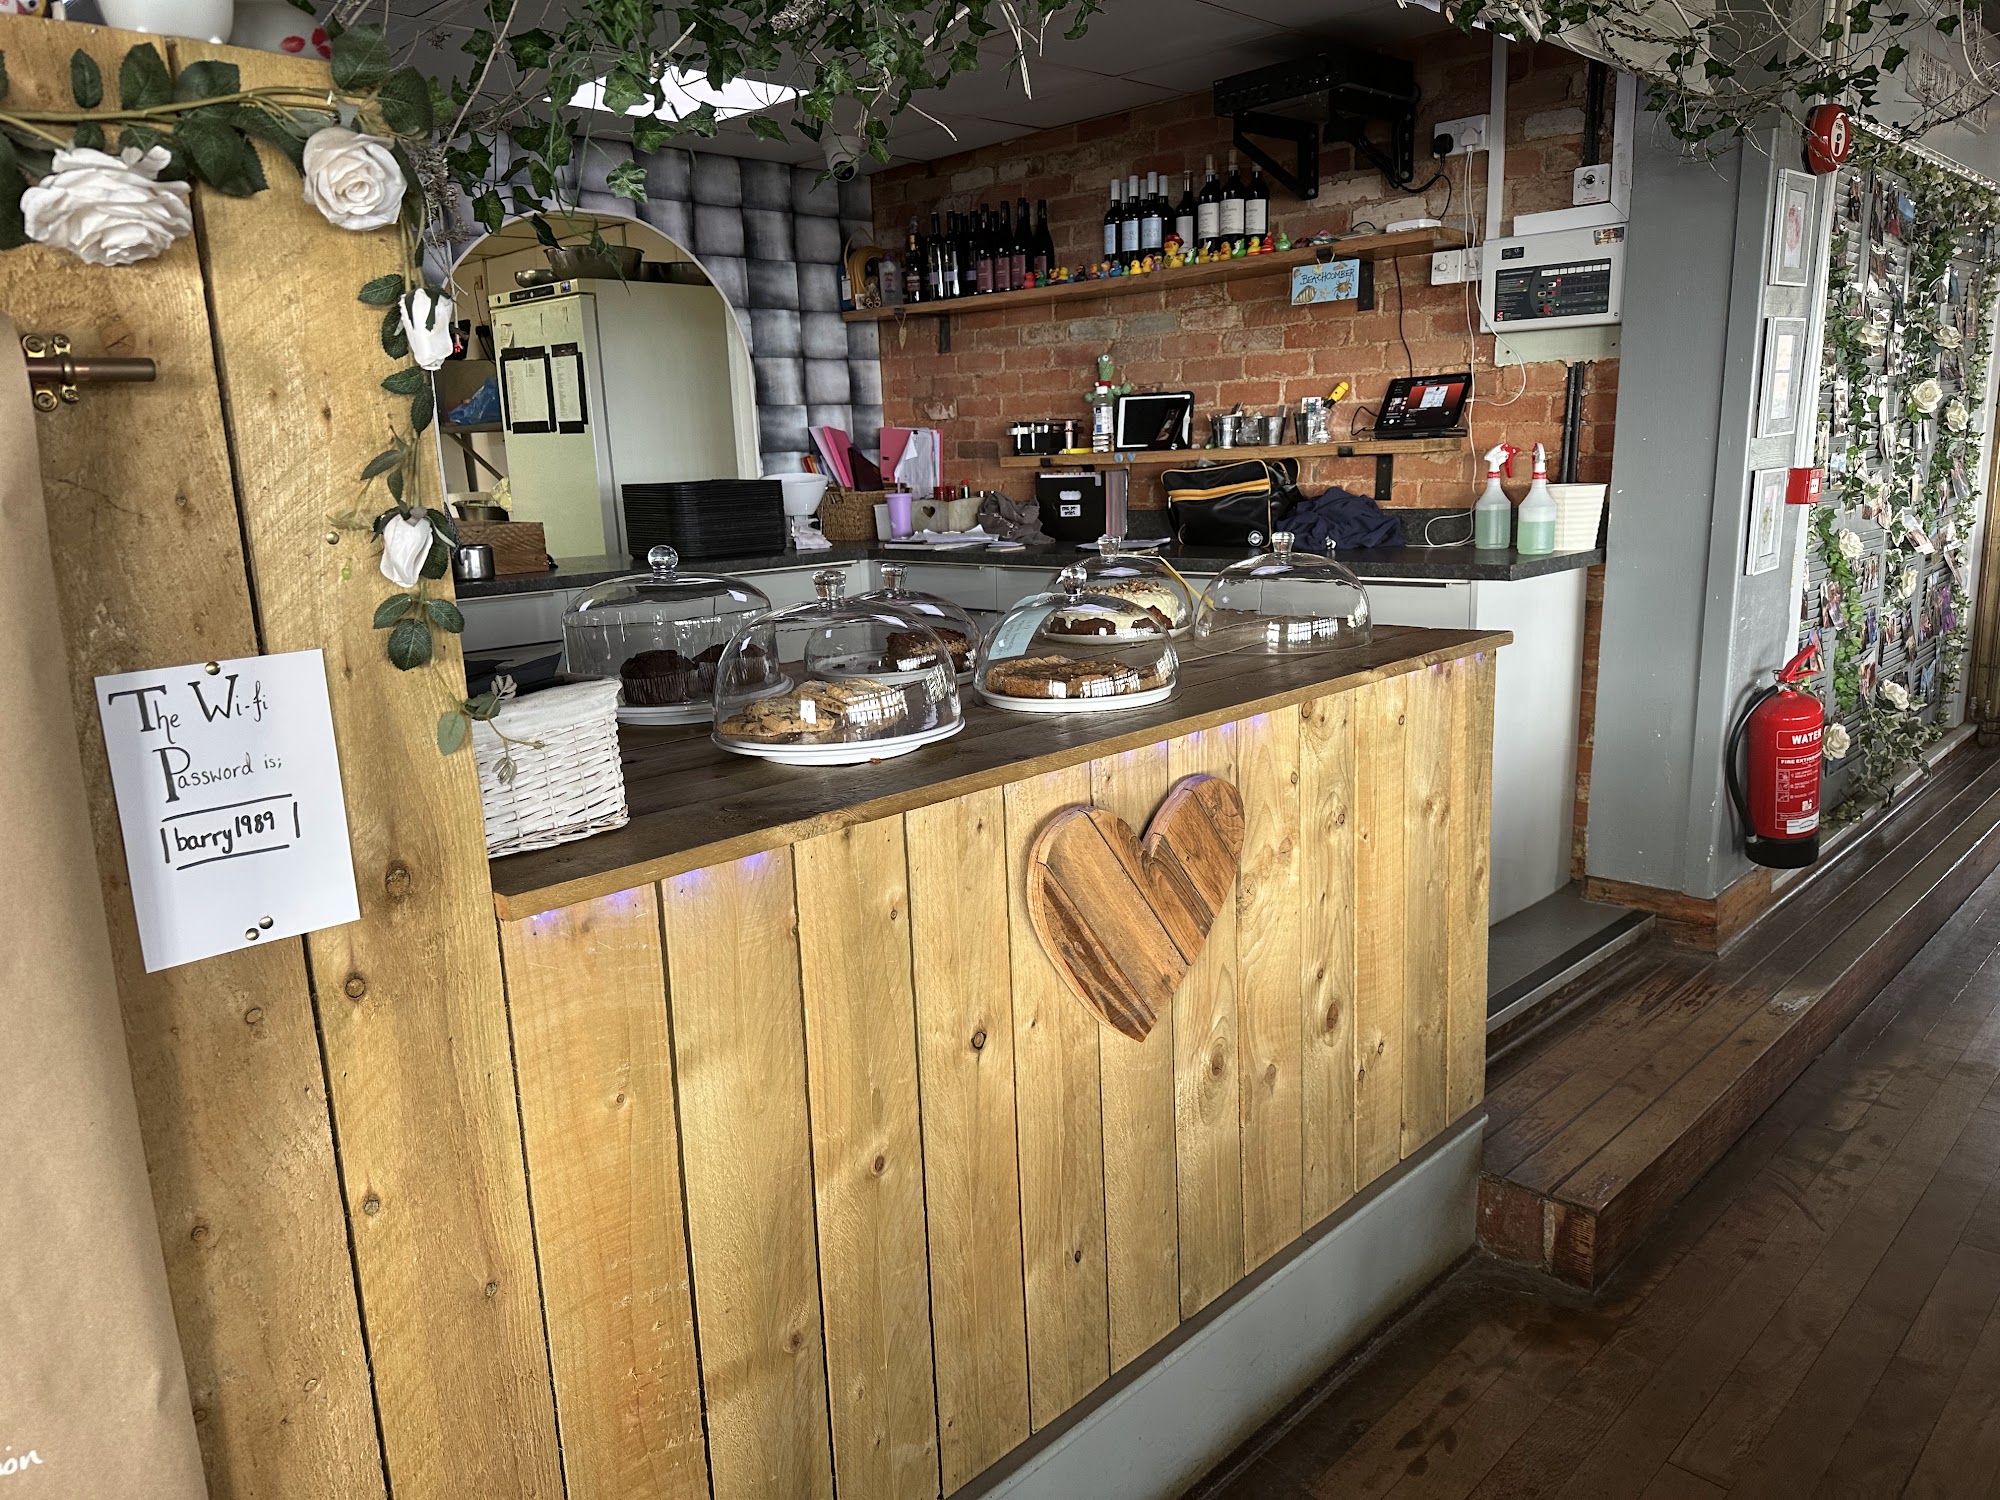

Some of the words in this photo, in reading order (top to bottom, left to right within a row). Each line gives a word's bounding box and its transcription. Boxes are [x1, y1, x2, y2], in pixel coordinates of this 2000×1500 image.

[108, 684, 181, 744] The
[188, 674, 269, 723] Wi-fi
[1792, 728, 1822, 745] WATER
[152, 746, 254, 804] Password
[175, 810, 275, 853] barry1989
